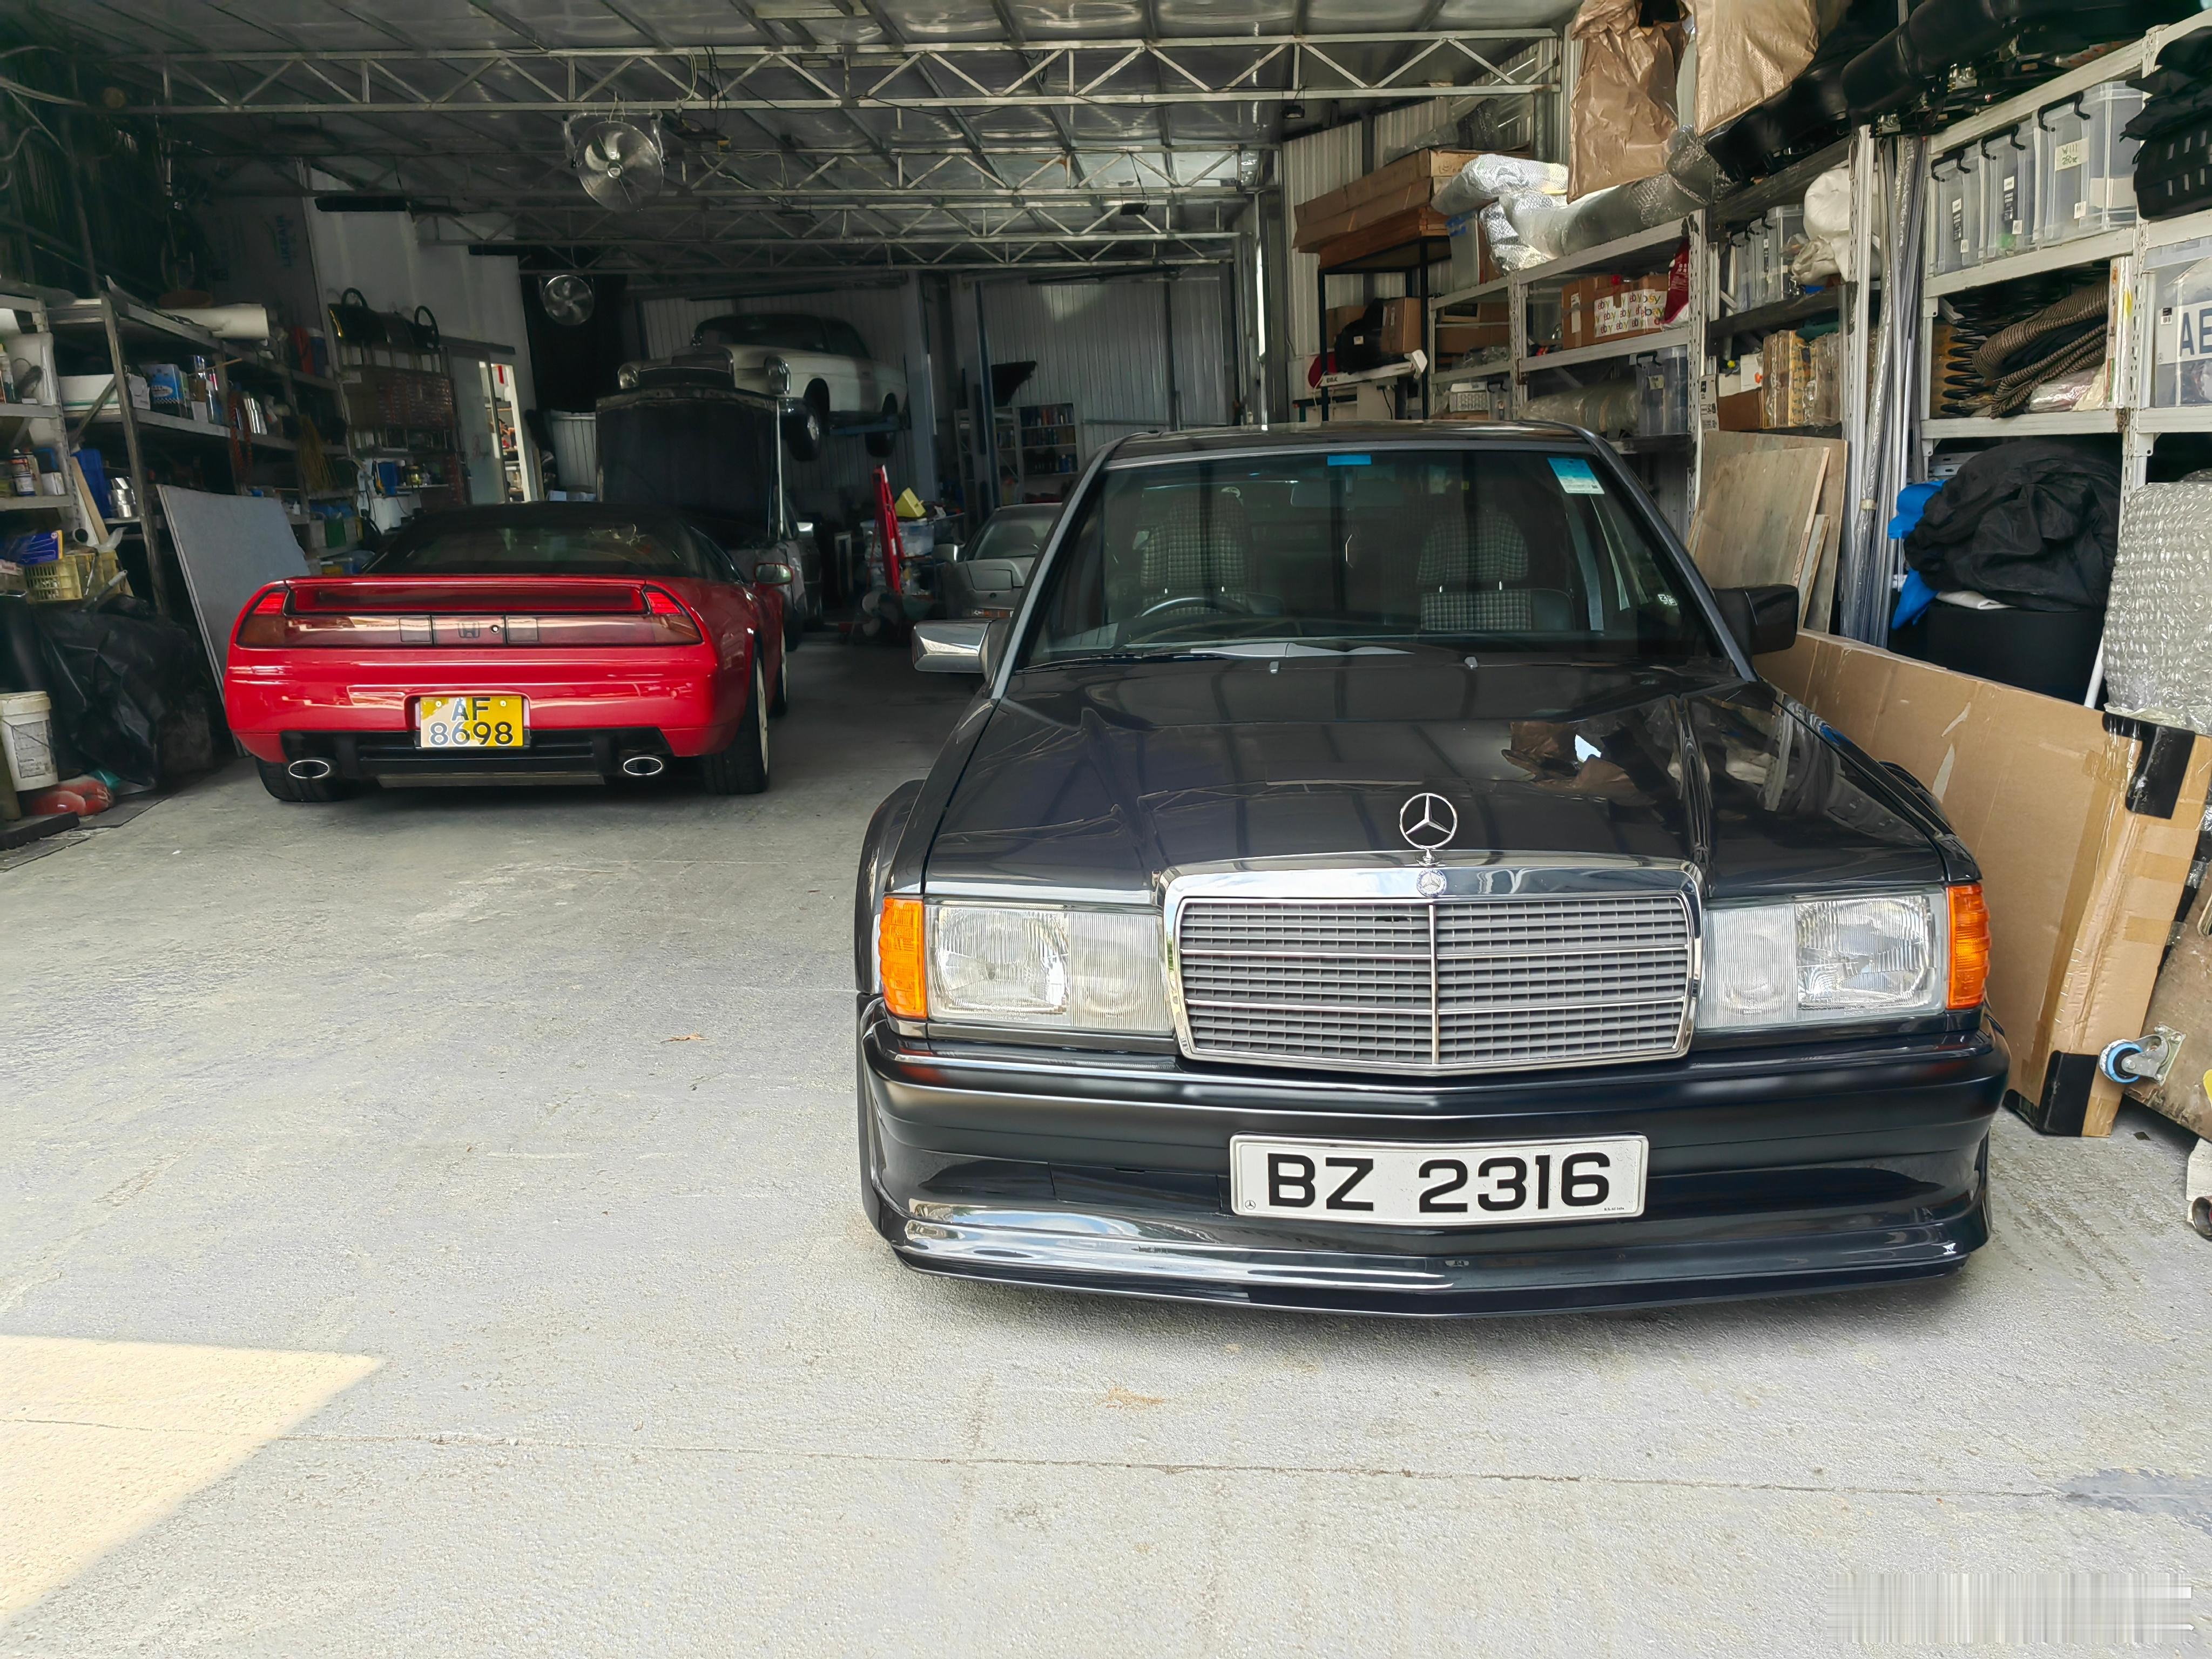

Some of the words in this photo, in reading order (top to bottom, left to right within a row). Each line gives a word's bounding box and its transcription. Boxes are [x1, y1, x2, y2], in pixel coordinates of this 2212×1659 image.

[451, 697, 491, 721] AF
[429, 721, 514, 746] 8698
[1267, 1152, 1374, 1210] BZ
[1419, 1152, 1611, 1213] 2316
